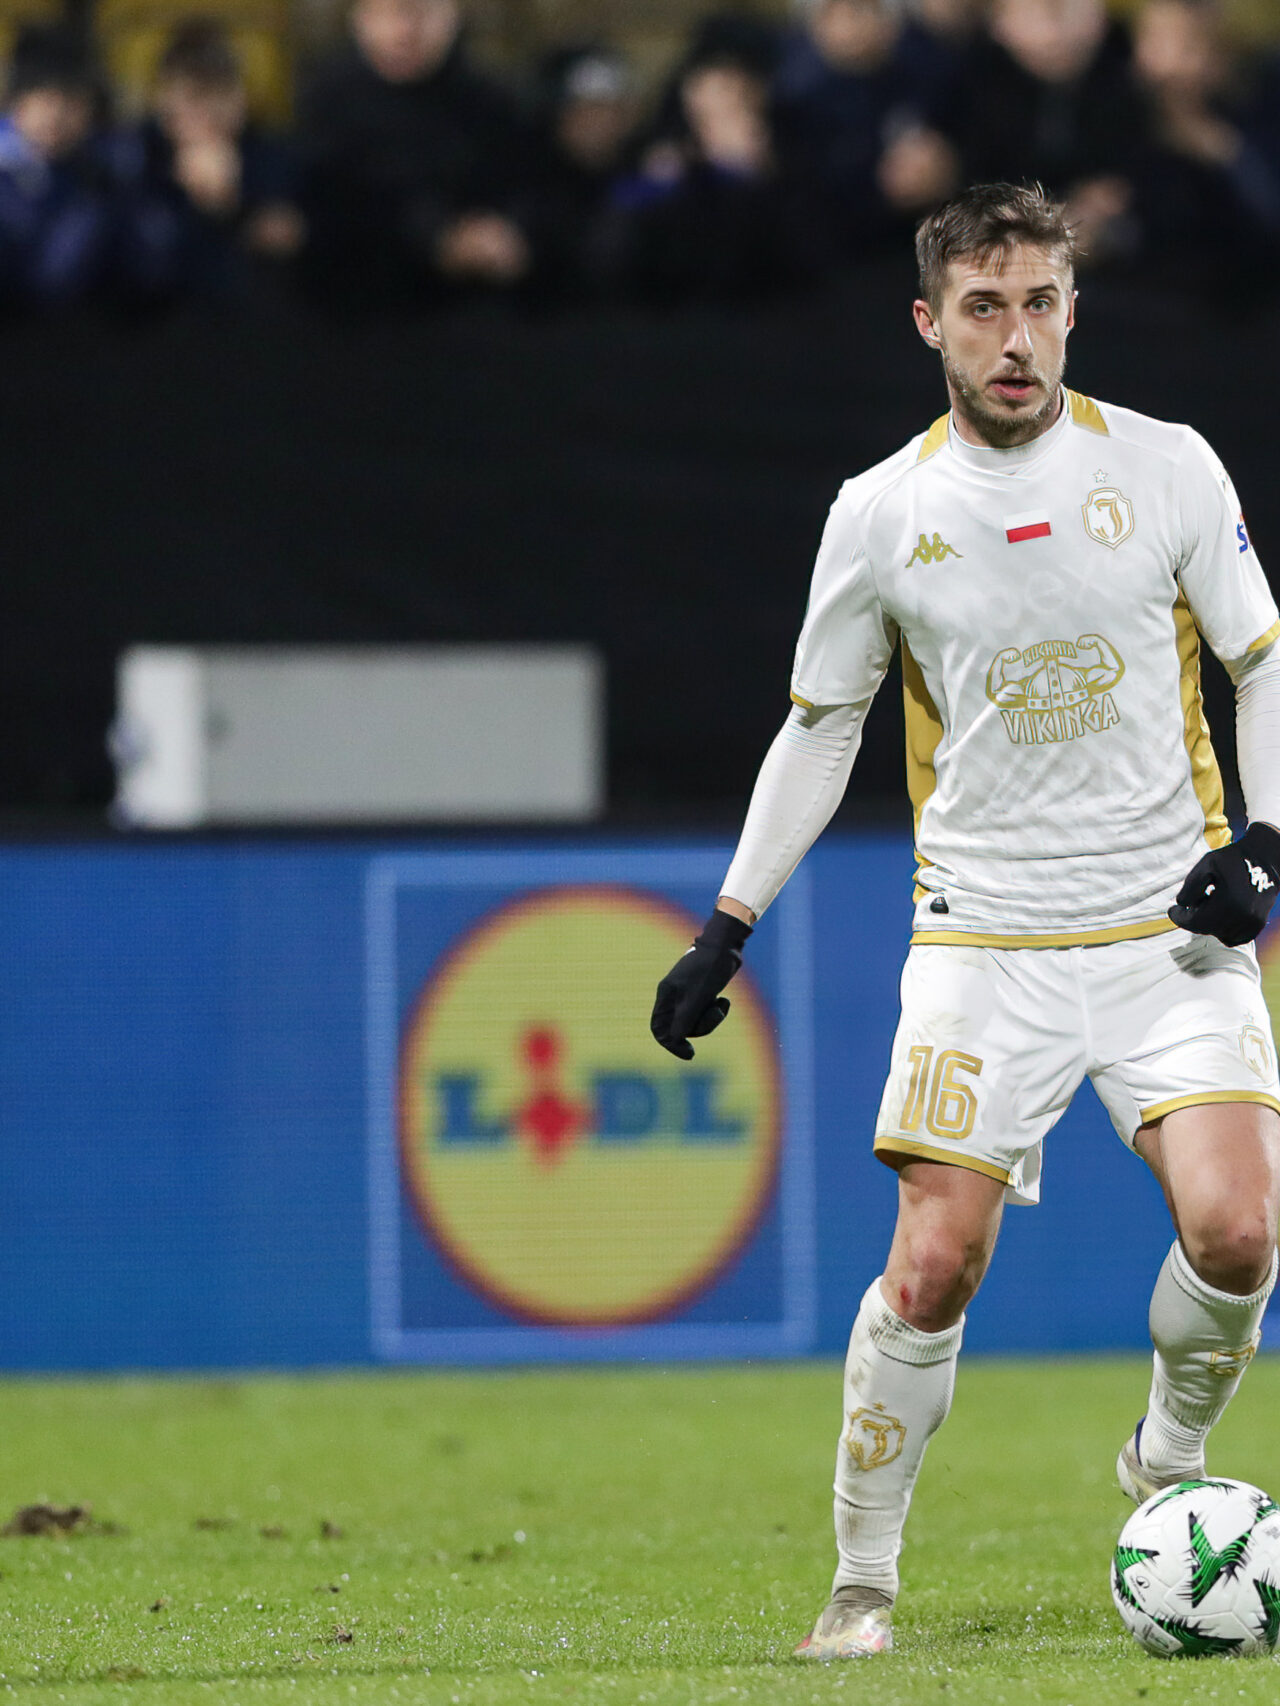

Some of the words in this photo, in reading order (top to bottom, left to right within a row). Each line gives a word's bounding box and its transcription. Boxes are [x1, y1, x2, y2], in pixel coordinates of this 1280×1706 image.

[1022, 640, 1077, 668] KUCHNIA
[1000, 693, 1120, 744] VIKINGA
[899, 1044, 983, 1139] 16
